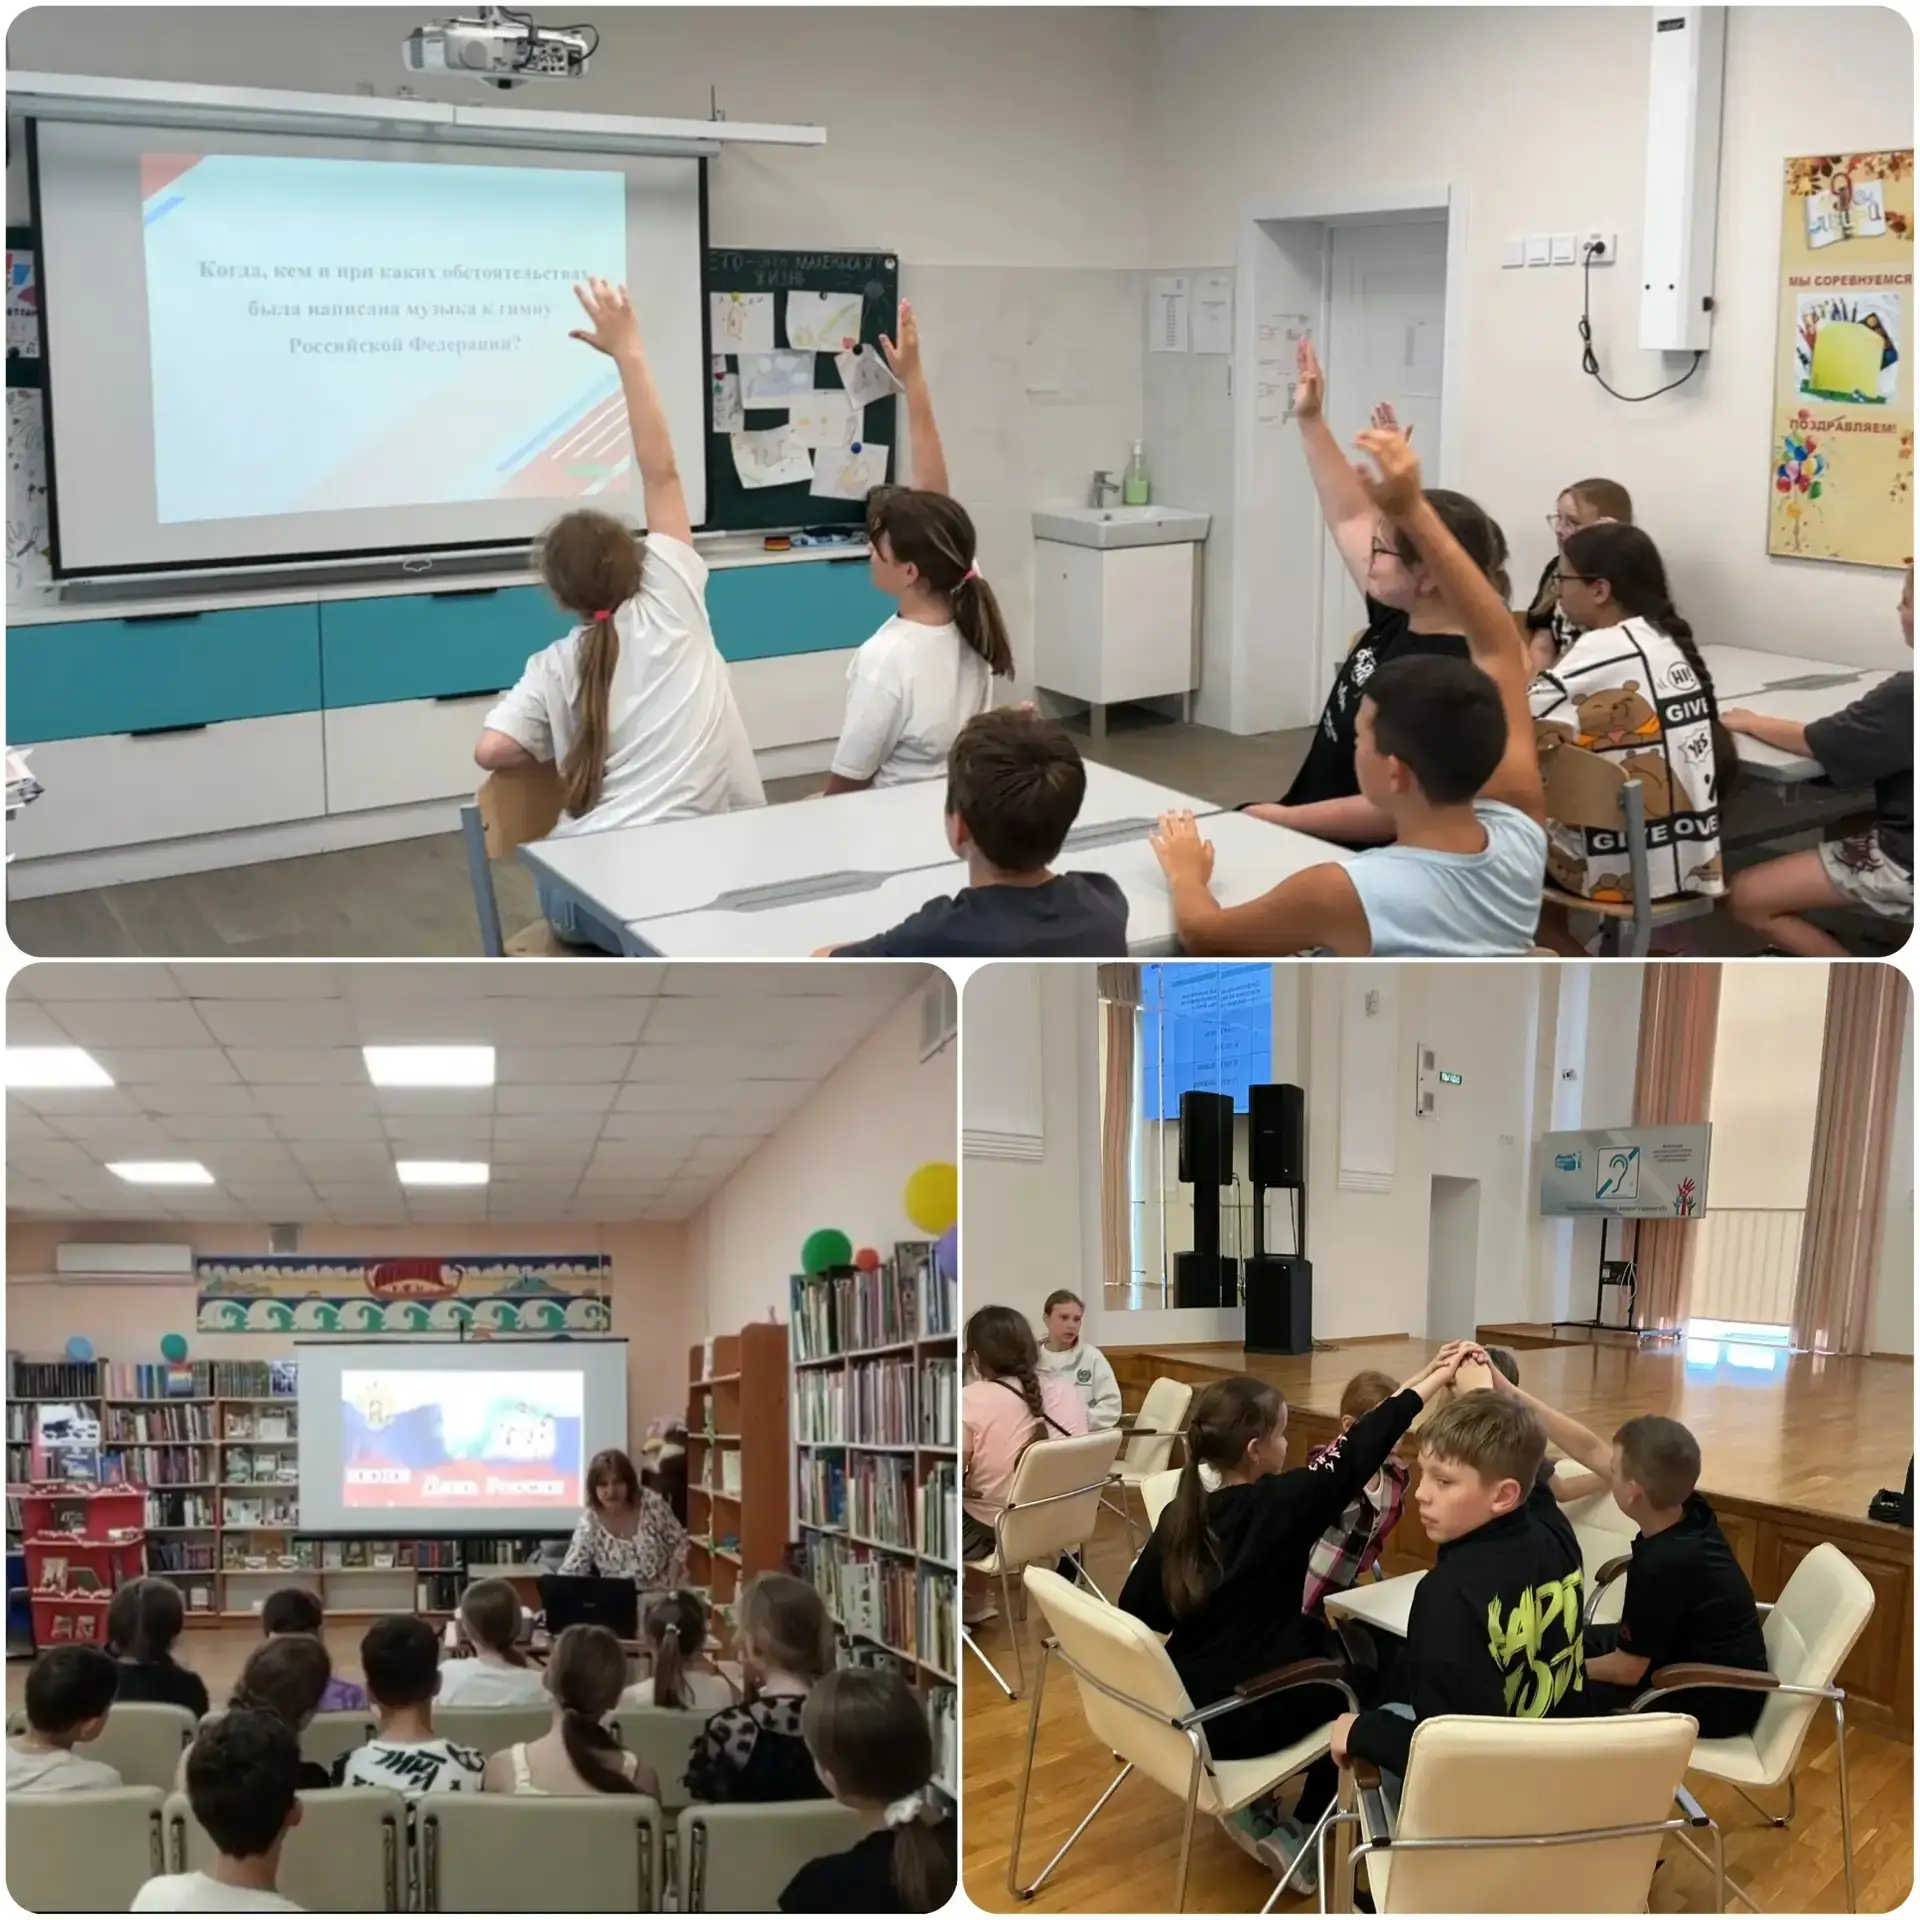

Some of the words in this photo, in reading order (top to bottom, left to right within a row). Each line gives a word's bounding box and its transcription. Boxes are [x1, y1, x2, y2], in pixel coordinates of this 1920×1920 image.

[199, 260, 268, 280] Когда,
[273, 264, 312, 279] кем
[318, 265, 330, 279] и
[337, 265, 374, 282] при
[380, 266, 437, 280] каких
[442, 263, 588, 281] обстоятельствах
[1788, 275, 1812, 287] МЫ
[1814, 273, 1913, 287] СОРЕВНУЕМСЯ
[248, 300, 301, 317] была
[308, 302, 400, 317] написана
[405, 302, 477, 320] музыка
[482, 303, 494, 316] к
[499, 303, 551, 318] гимну
[289, 337, 403, 354] Российской
[409, 335, 521, 356] Федерации?
[1789, 418, 1897, 434] ПОЗДРАВЛЯЕМ!
[1671, 666, 1695, 684] HI!
[1688, 732, 1708, 756] YES
[1593, 823, 1668, 849] GIE
